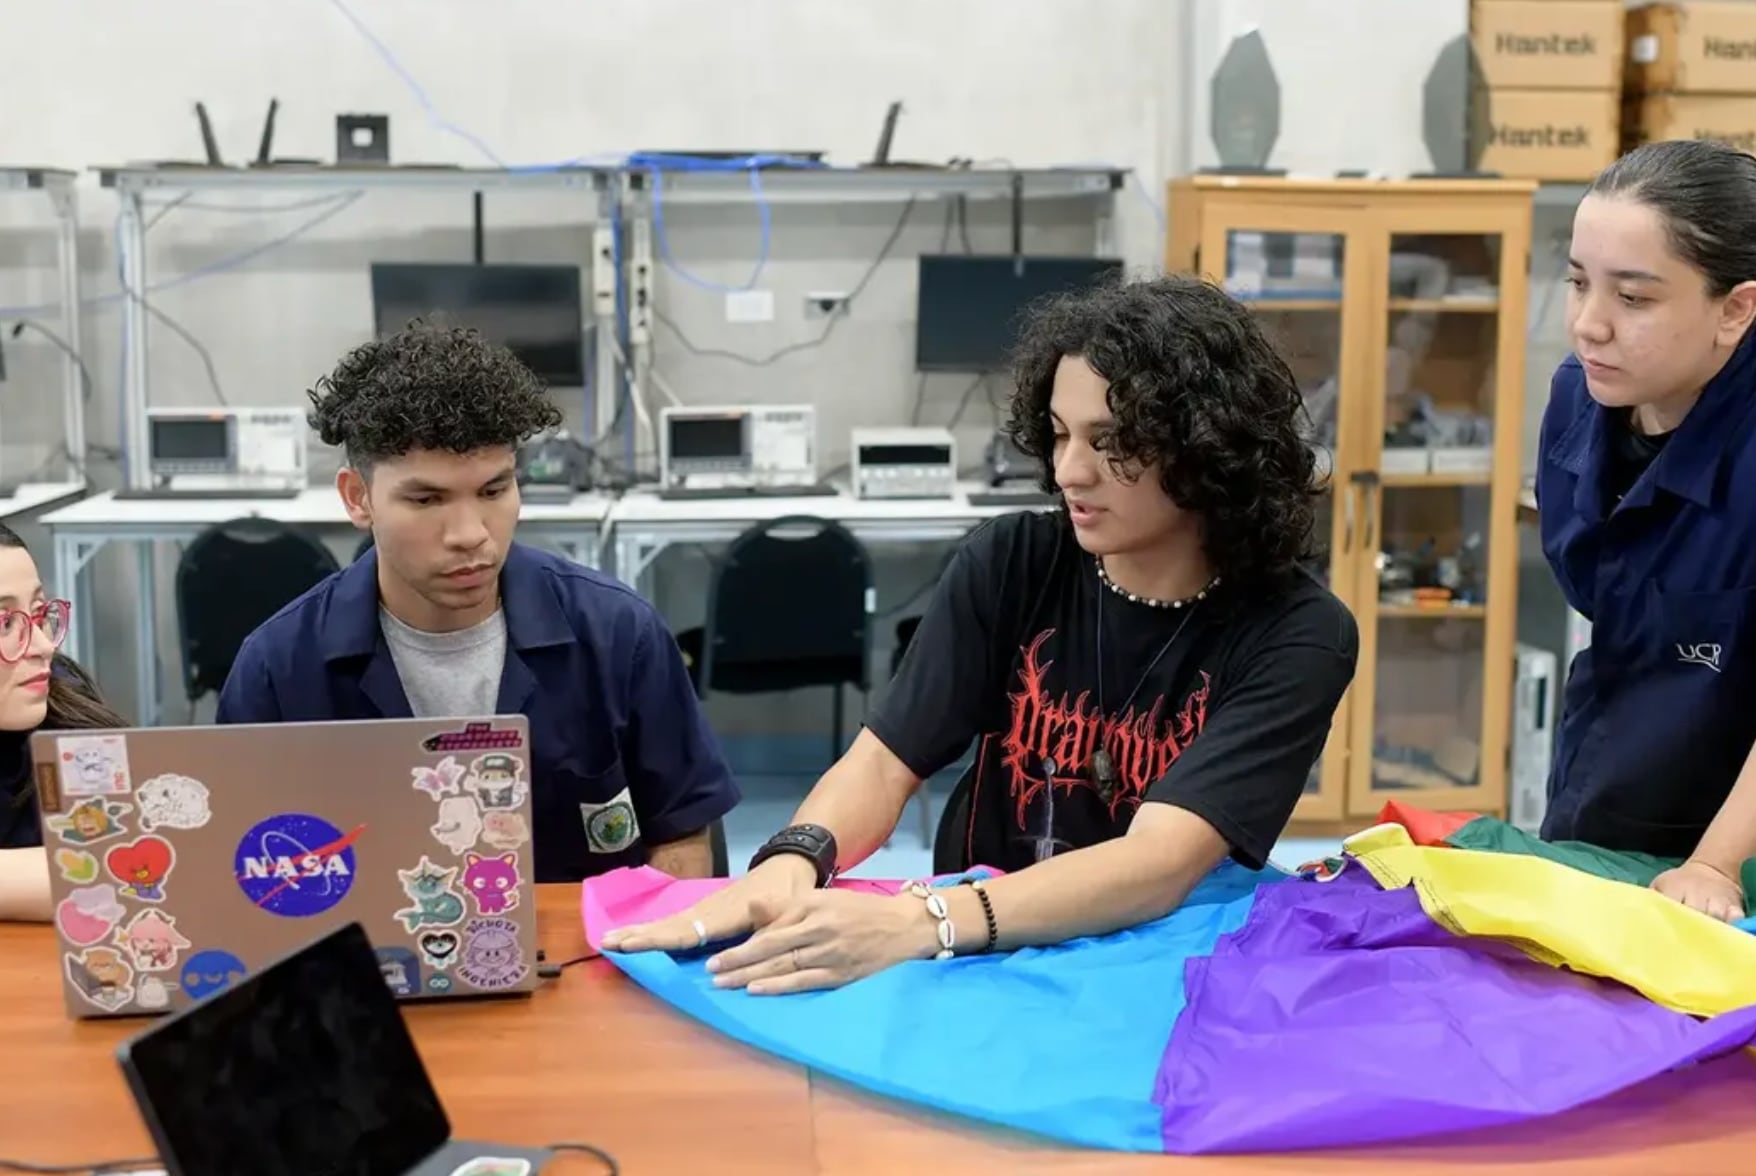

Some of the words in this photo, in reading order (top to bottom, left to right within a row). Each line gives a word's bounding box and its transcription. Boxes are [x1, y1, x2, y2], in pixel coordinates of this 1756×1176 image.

[1496, 34, 1594, 55] Hantek
[1490, 125, 1589, 147] Hantek
[1676, 643, 1721, 666] UCR
[243, 854, 350, 879] NASA
